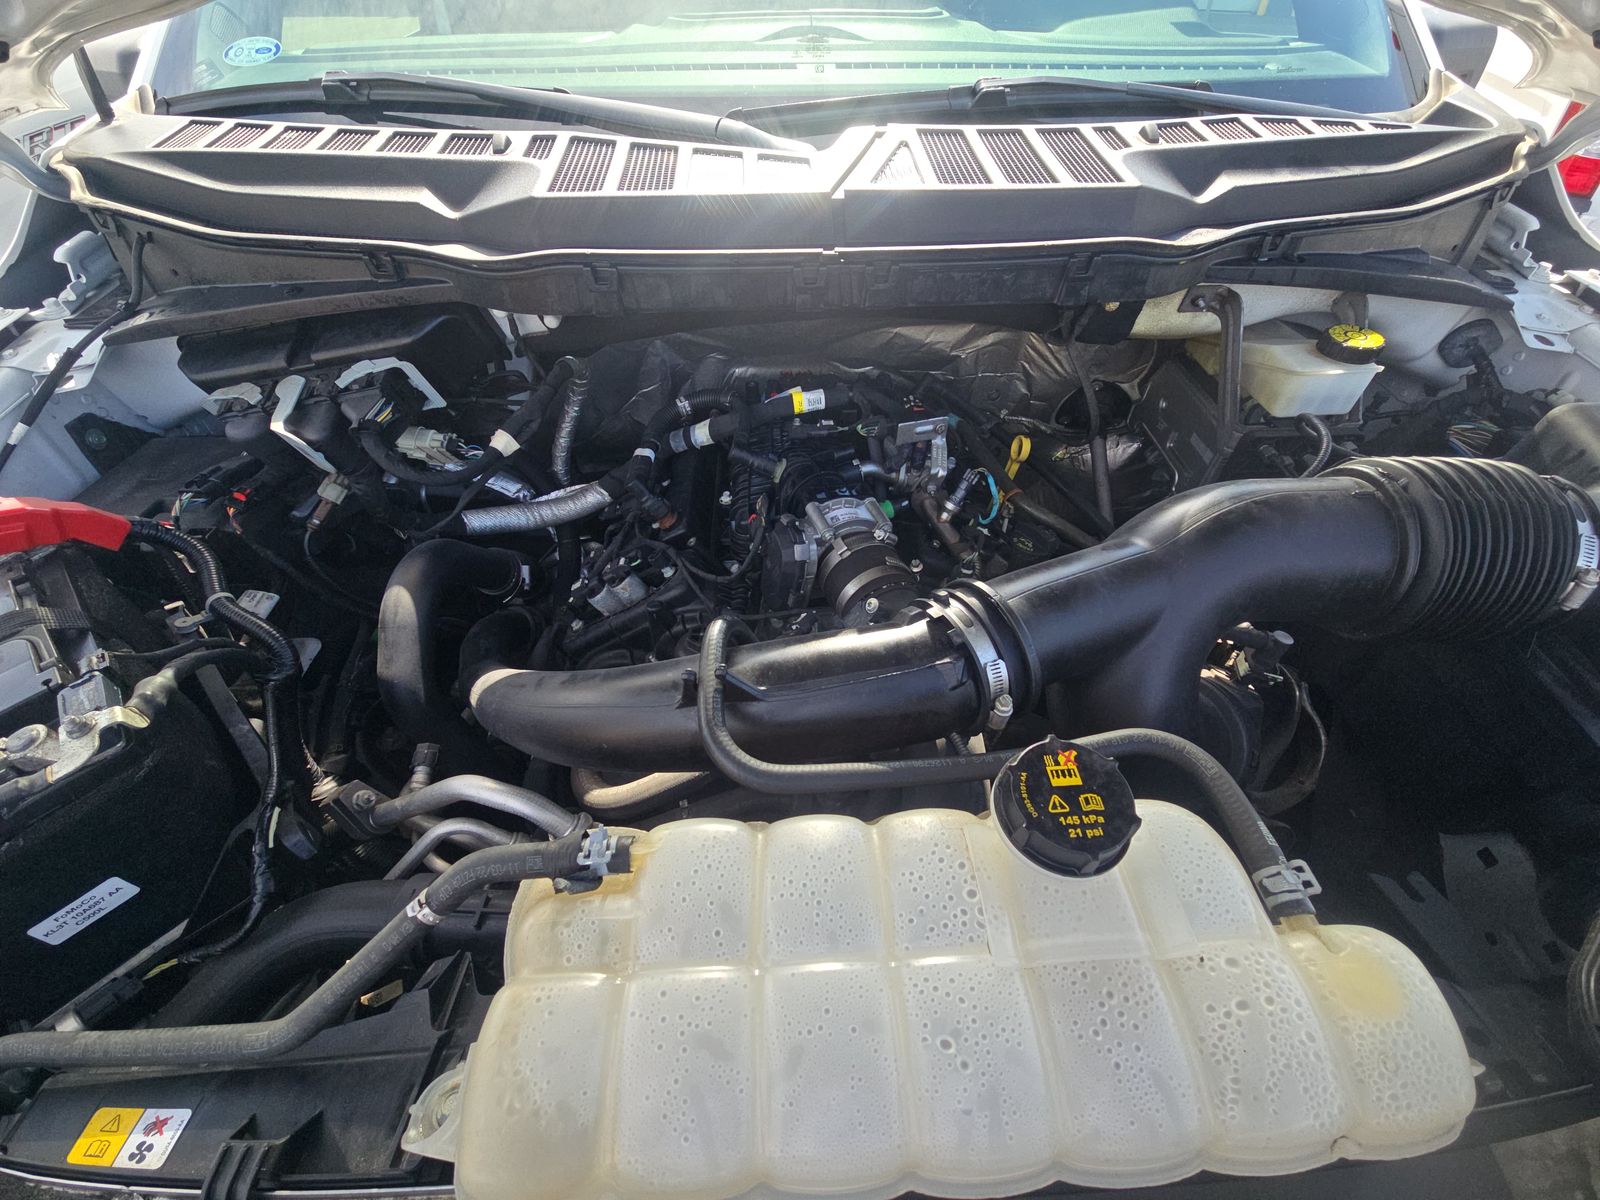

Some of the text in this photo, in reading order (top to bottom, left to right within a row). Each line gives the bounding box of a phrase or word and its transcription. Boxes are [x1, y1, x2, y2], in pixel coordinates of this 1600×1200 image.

[1059, 815, 1105, 826] 145 kPa
[1068, 827, 1104, 839] 21 psi
[43, 921, 69, 938] KL3T
[108, 886, 124, 897] AA
[53, 895, 97, 923] FoMoCo
